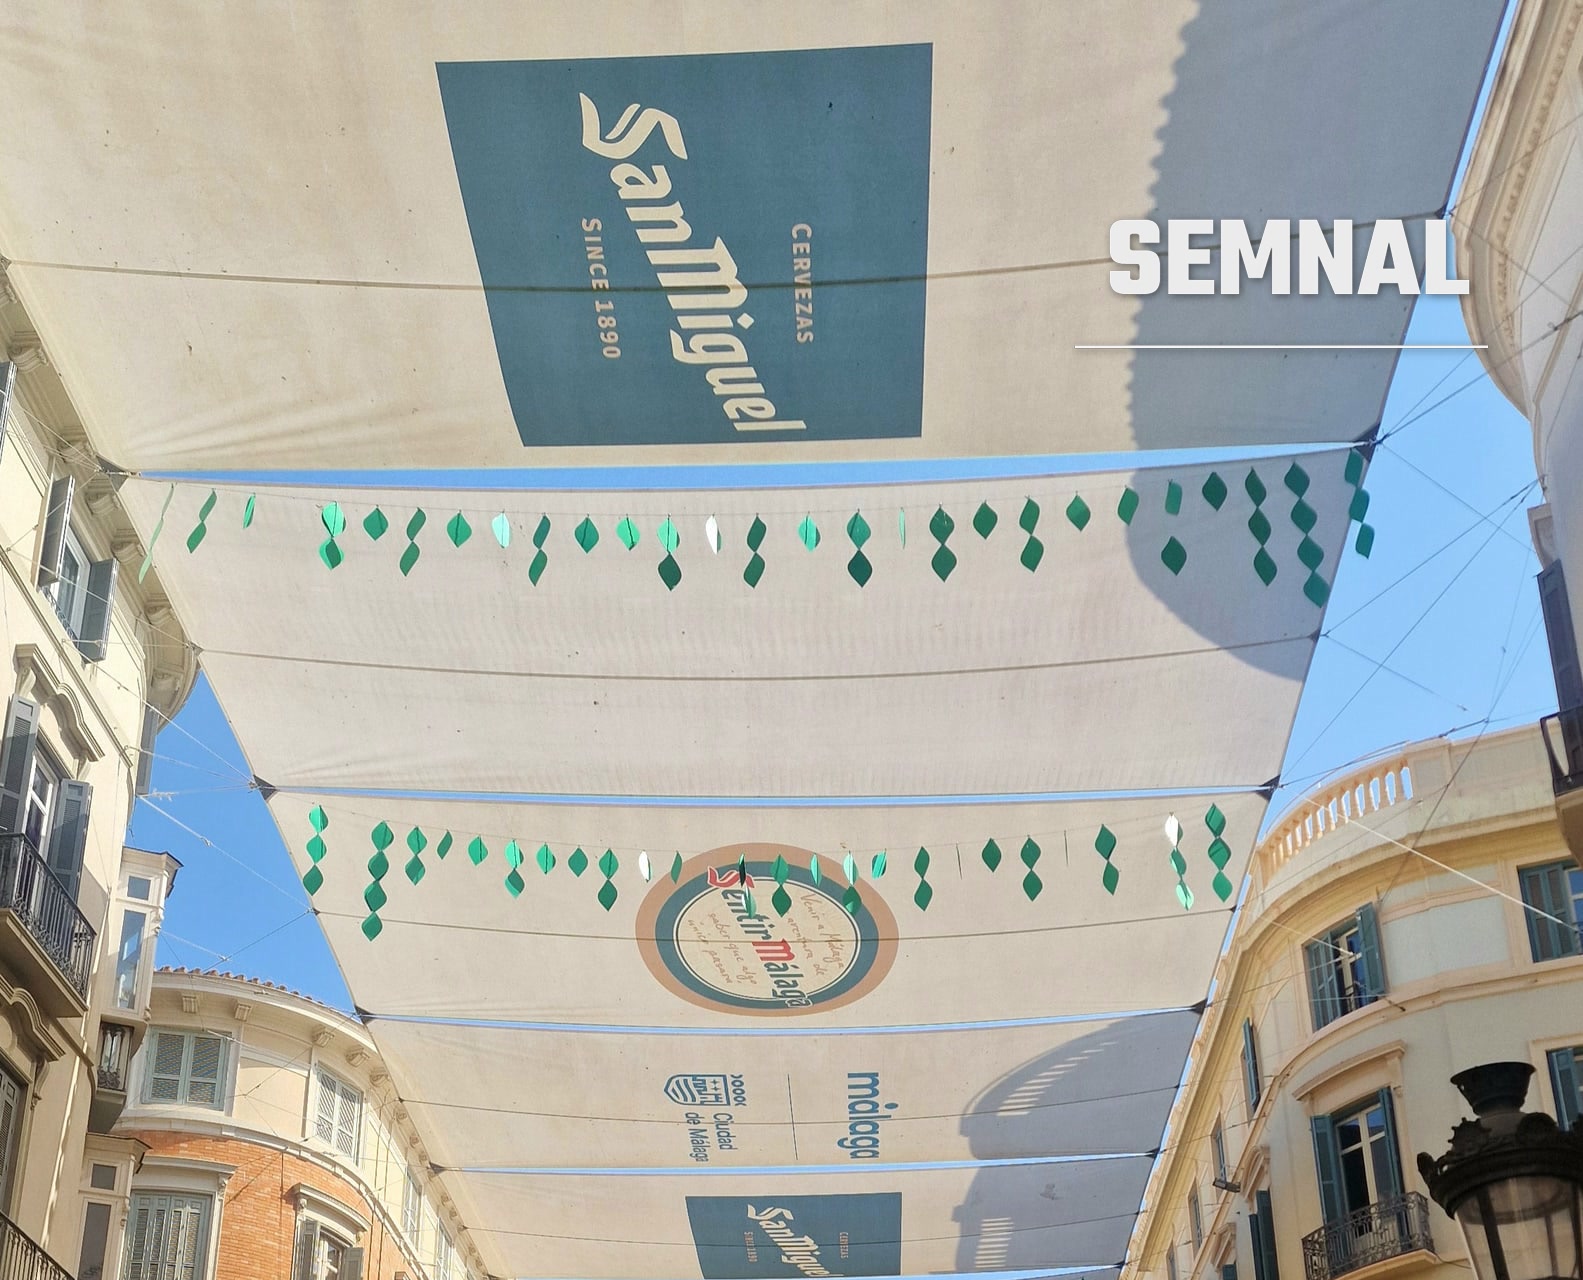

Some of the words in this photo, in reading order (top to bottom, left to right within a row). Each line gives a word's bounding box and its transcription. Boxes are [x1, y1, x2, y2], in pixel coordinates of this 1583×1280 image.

[580, 217, 610, 291] SINCE
[791, 223, 814, 344] CERVEZAS
[594, 299, 622, 359] 1890
[801, 893, 825, 920] Venir
[819, 933, 845, 968] Málaga
[685, 1112, 700, 1127] de
[689, 1128, 712, 1162] Málaga
[713, 1112, 738, 1150] Ciudad
[837, 1072, 899, 1158] málaga
